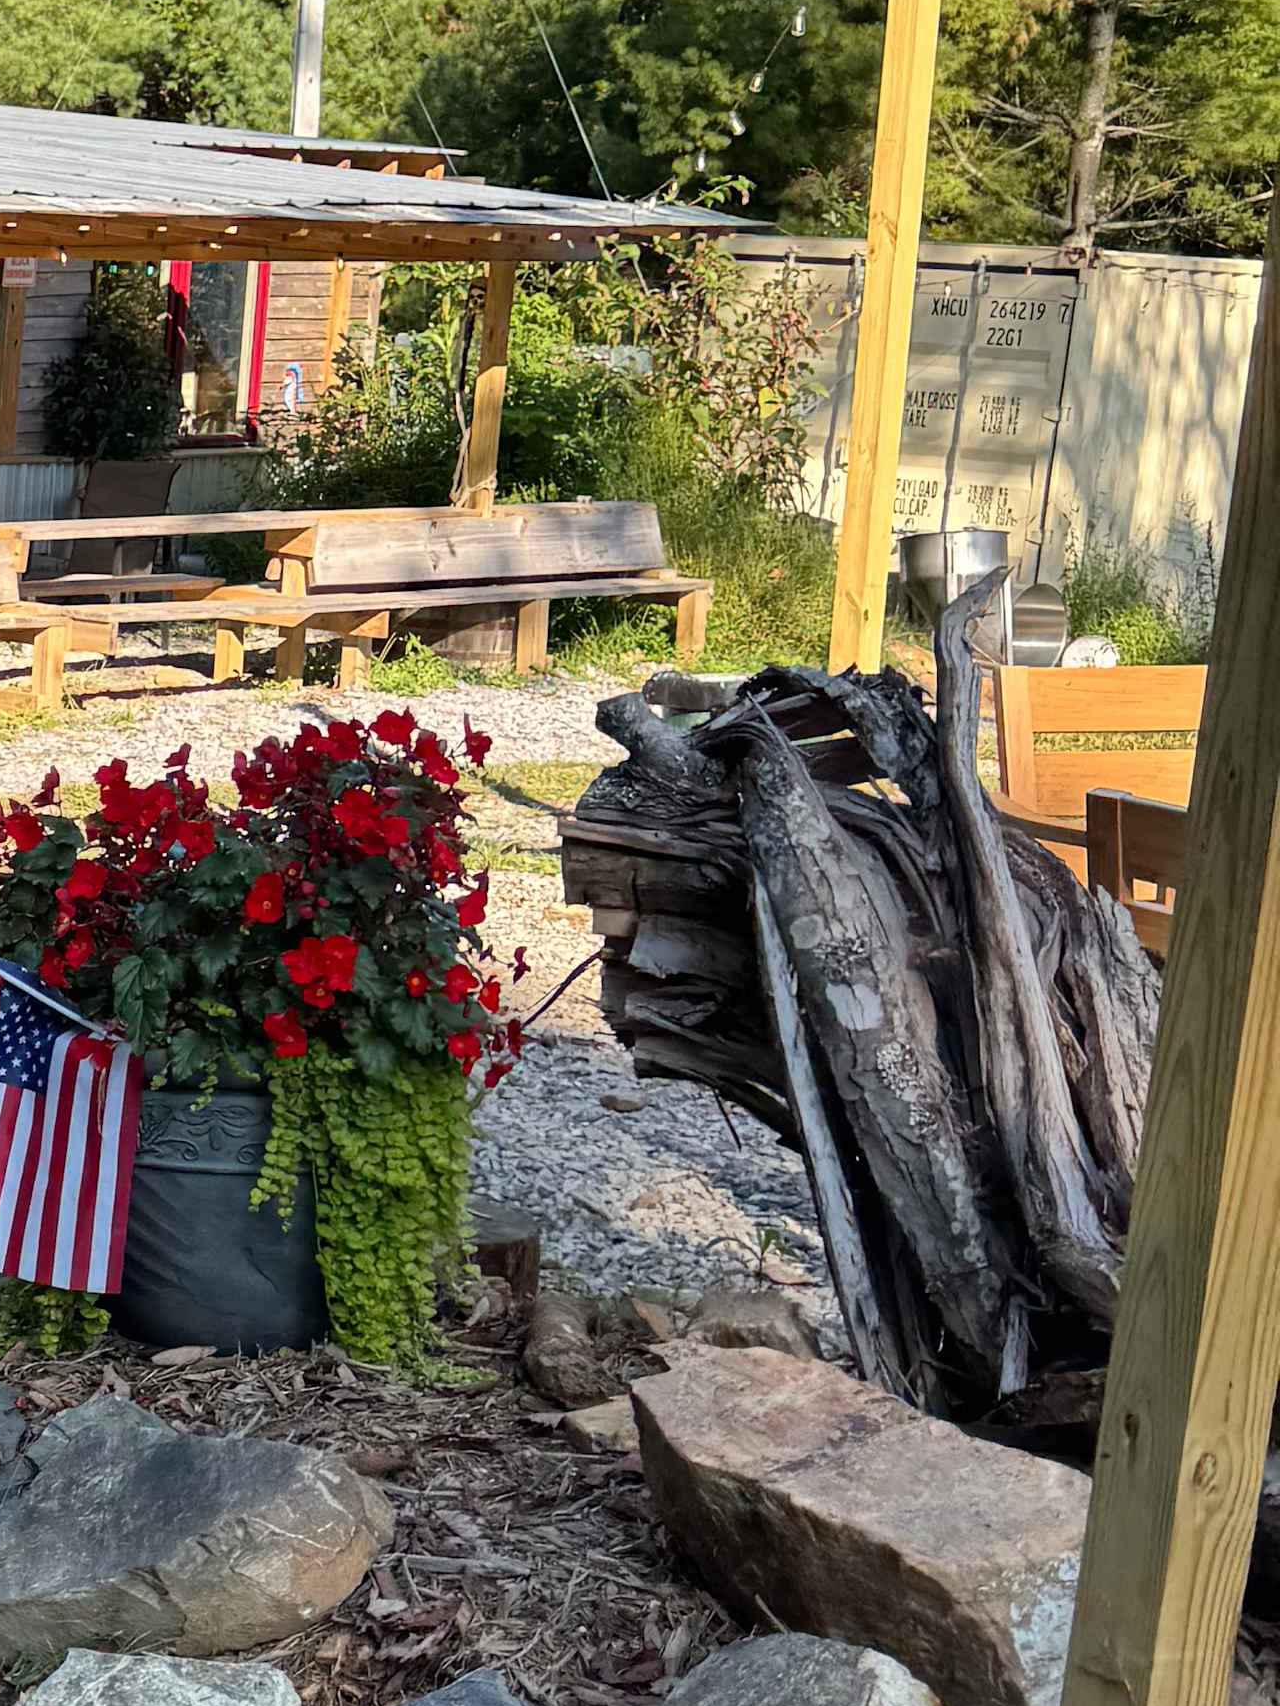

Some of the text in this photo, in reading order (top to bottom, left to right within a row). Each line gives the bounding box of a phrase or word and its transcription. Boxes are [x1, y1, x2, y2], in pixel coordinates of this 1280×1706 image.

[931, 296, 968, 318] XHCU
[989, 300, 1047, 321] 264219
[986, 327, 1024, 347] 22G1
[895, 478, 938, 498] PAYLOAD
